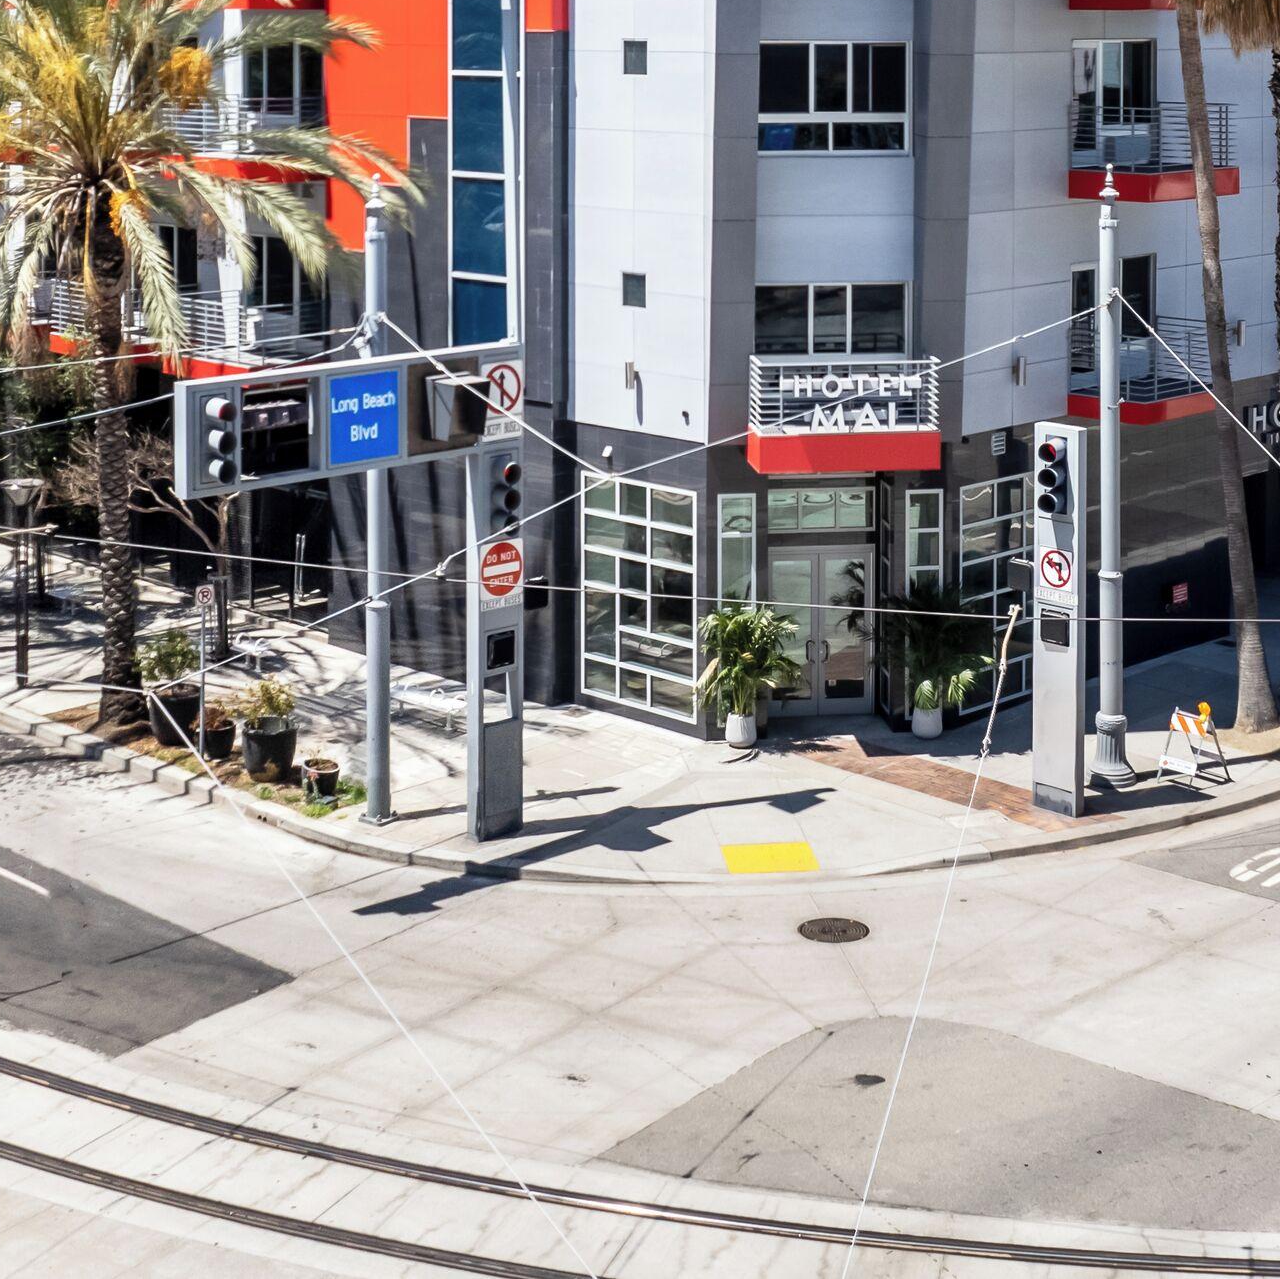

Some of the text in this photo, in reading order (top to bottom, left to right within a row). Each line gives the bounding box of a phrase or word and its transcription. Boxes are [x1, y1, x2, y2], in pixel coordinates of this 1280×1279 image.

[793, 373, 913, 398] HOTEL
[331, 390, 395, 414] Long Beach
[810, 402, 896, 433] MAI
[350, 423, 378, 442] Blvd
[486, 550, 517, 564] DO NOT
